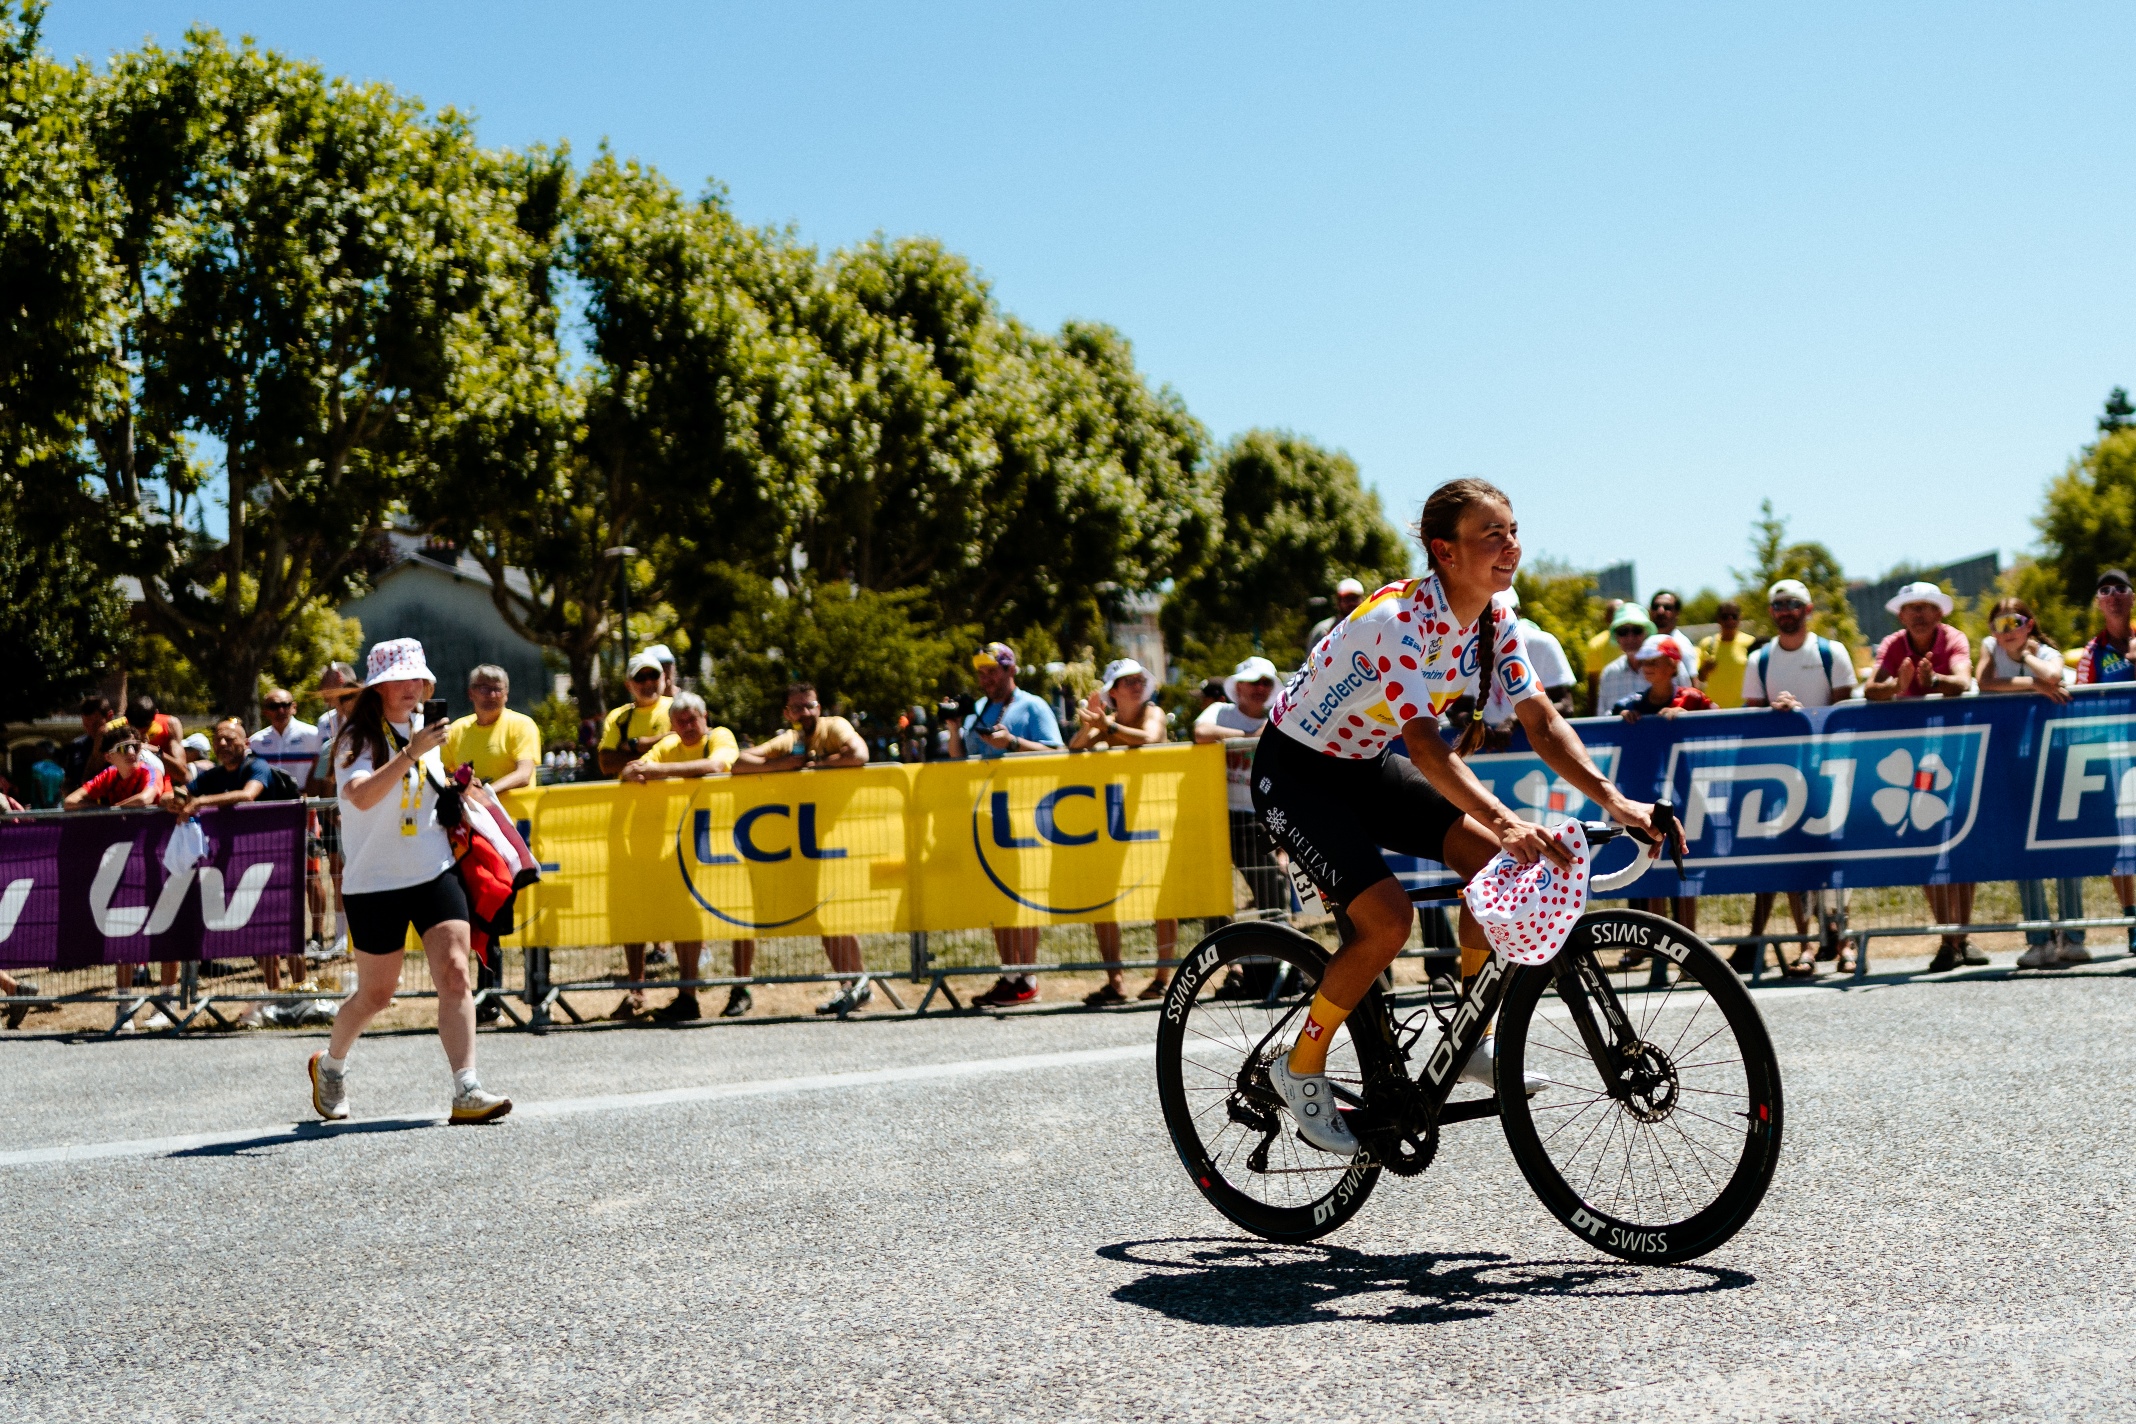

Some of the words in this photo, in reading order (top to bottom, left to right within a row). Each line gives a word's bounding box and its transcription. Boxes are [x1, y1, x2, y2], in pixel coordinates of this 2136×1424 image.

[1420, 668, 1447, 680] antini
[1299, 672, 1363, 737] E.Leclerc
[991, 783, 1161, 848] LCL
[1684, 758, 1858, 841] FDJ
[693, 802, 848, 865] LCL
[1288, 826, 1343, 887] REITAN
[1291, 870, 1317, 905] 131
[1591, 922, 1651, 946] SWISS
[1653, 934, 1691, 964] DT
[1197, 943, 1220, 976] DT
[1166, 966, 1197, 1025] SWISS
[1313, 1195, 1336, 1226] DT
[1570, 1207, 1607, 1237] DT
[1608, 1227, 1668, 1253] SWISS
